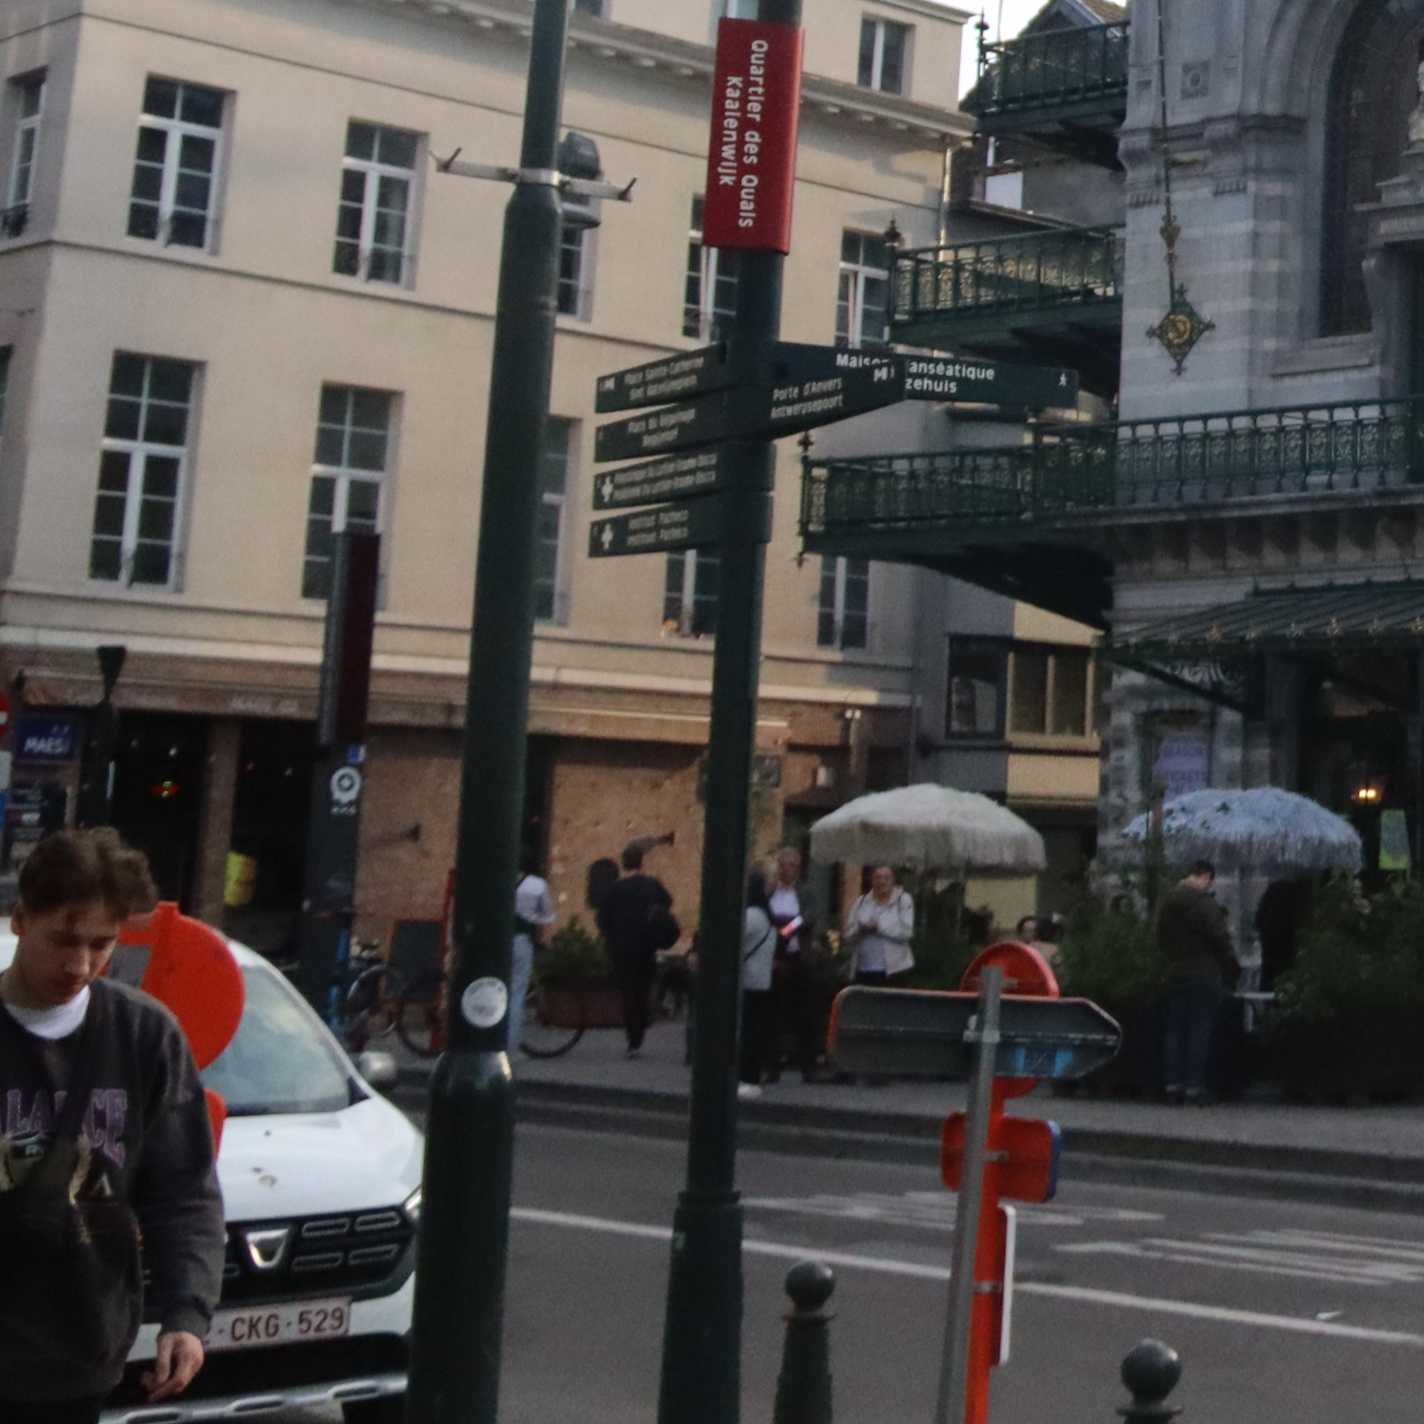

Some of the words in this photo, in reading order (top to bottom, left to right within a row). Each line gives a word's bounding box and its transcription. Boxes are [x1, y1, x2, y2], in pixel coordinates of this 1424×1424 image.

[746, 39, 769, 122] Quartier
[717, 76, 744, 186] Kaaienwijk
[742, 130, 763, 164] des
[738, 175, 759, 228] Quais
[772, 386, 799, 401] Porte
